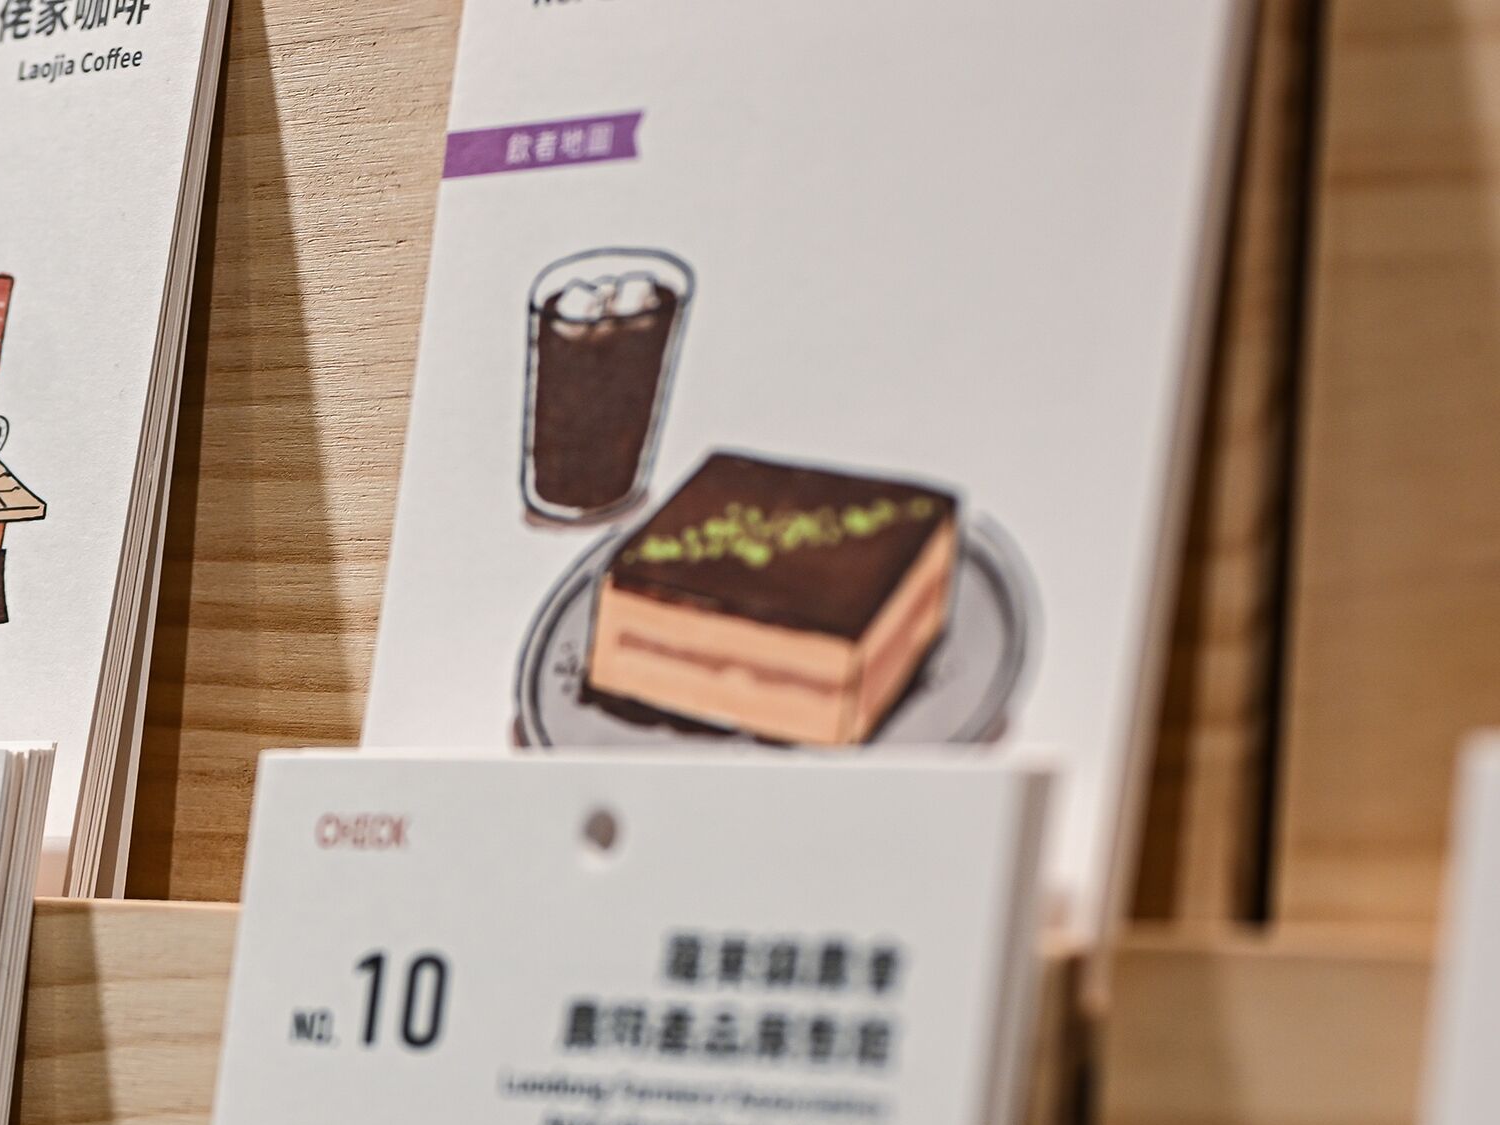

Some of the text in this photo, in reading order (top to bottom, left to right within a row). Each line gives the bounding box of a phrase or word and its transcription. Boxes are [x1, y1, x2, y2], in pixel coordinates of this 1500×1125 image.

[17, 46, 144, 83] Laojia Coffee
[355, 952, 448, 1050] 10
